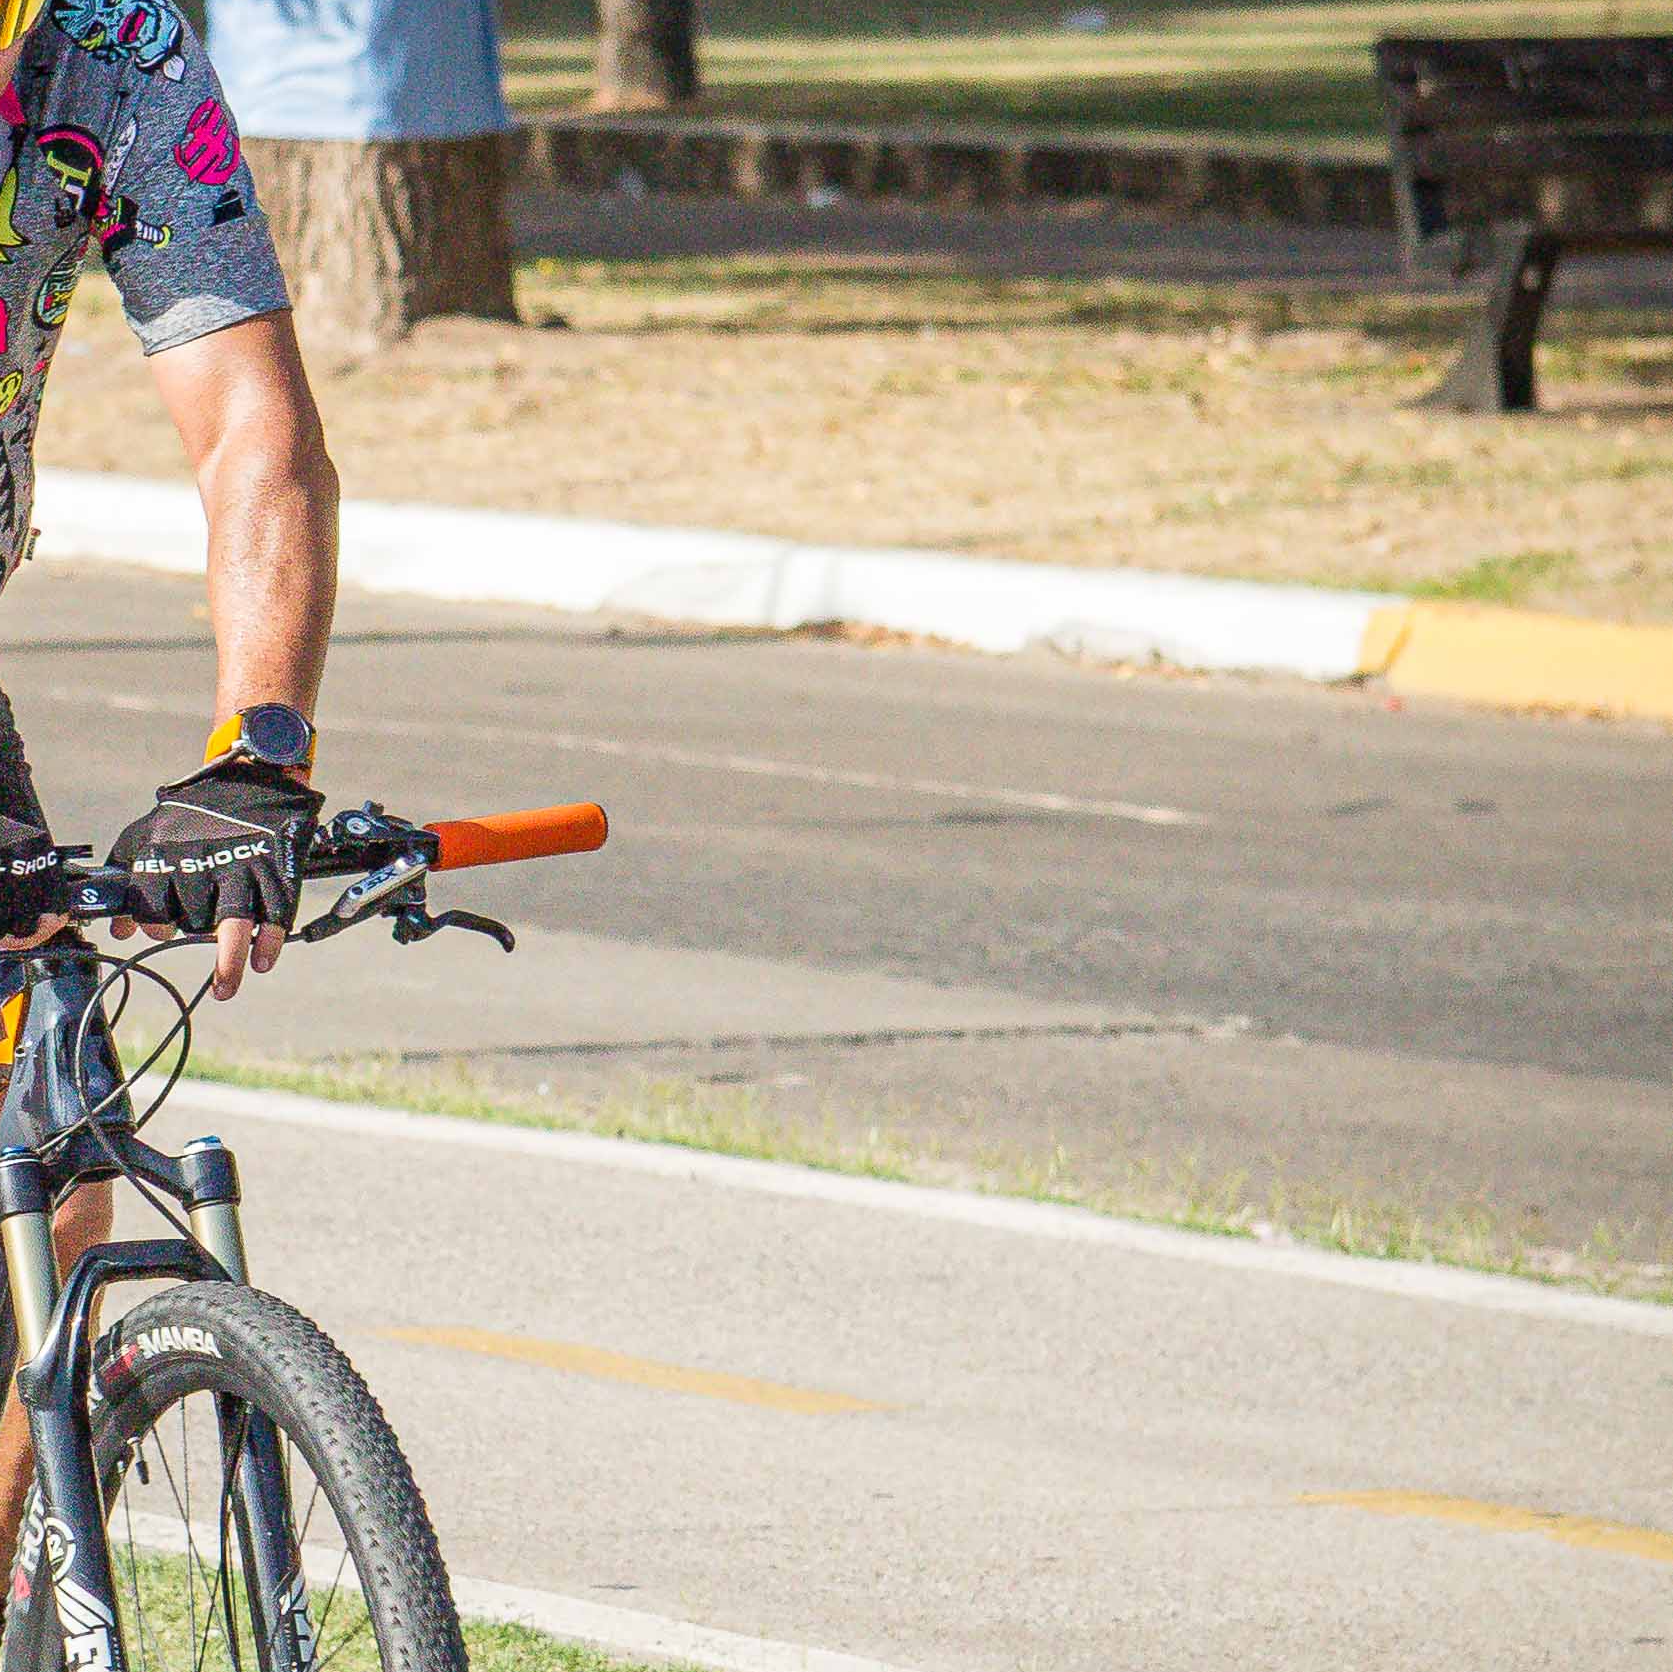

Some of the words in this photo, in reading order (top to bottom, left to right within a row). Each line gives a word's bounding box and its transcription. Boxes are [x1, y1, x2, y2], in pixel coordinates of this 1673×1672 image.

[132, 859, 177, 874] GEL
[179, 839, 272, 874] SHOCK
[137, 1326, 224, 1360] MAMBA
